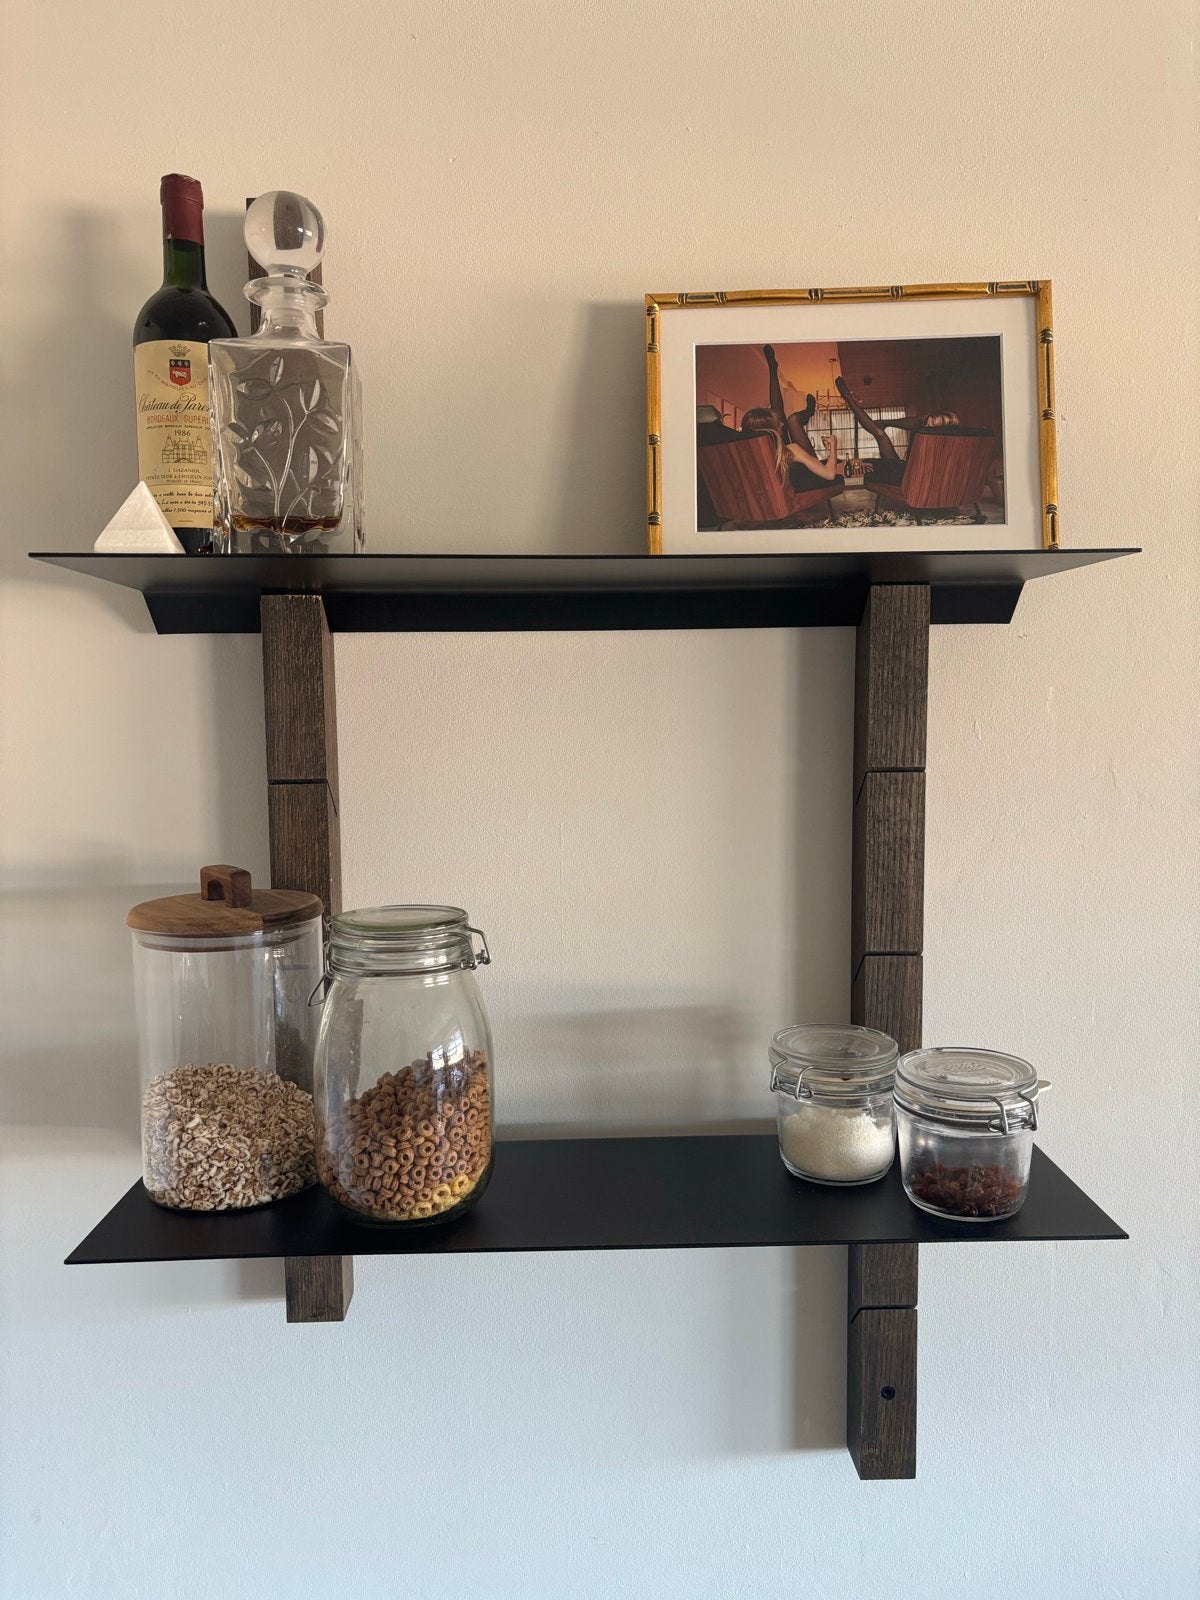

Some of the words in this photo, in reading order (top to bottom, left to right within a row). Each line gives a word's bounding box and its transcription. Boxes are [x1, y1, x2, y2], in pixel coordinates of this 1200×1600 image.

[169, 400, 182, 410] de
[146, 414, 179, 424] BORDEAUX
[174, 429, 191, 437] 1986
